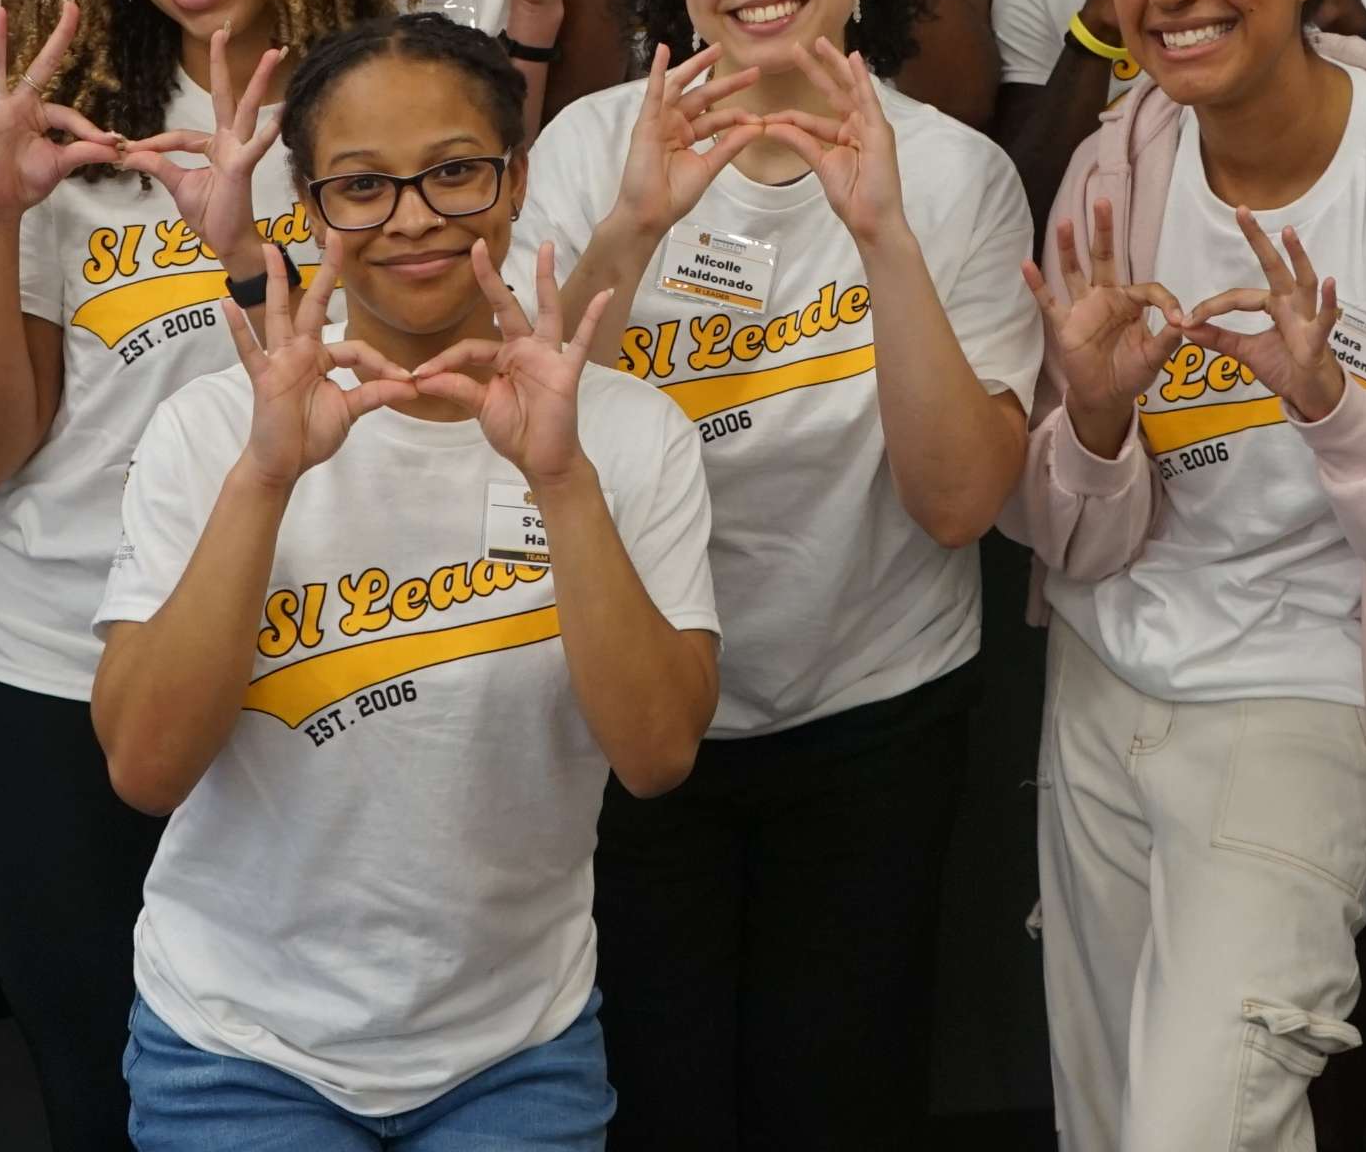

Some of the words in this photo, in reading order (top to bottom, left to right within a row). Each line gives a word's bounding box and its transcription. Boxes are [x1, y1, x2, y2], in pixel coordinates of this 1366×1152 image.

[677, 264, 754, 292] Maldonado
[694, 253, 742, 274] Nicolle
[118, 330, 162, 365] EST.
[162, 307, 216, 339] 2006
[687, 280, 871, 371] Leade
[1333, 330, 1362, 352] Kara
[698, 409, 753, 443] 2006
[1179, 442, 1229, 471] 2006
[304, 709, 356, 748] EST.
[355, 680, 418, 719] 2006
